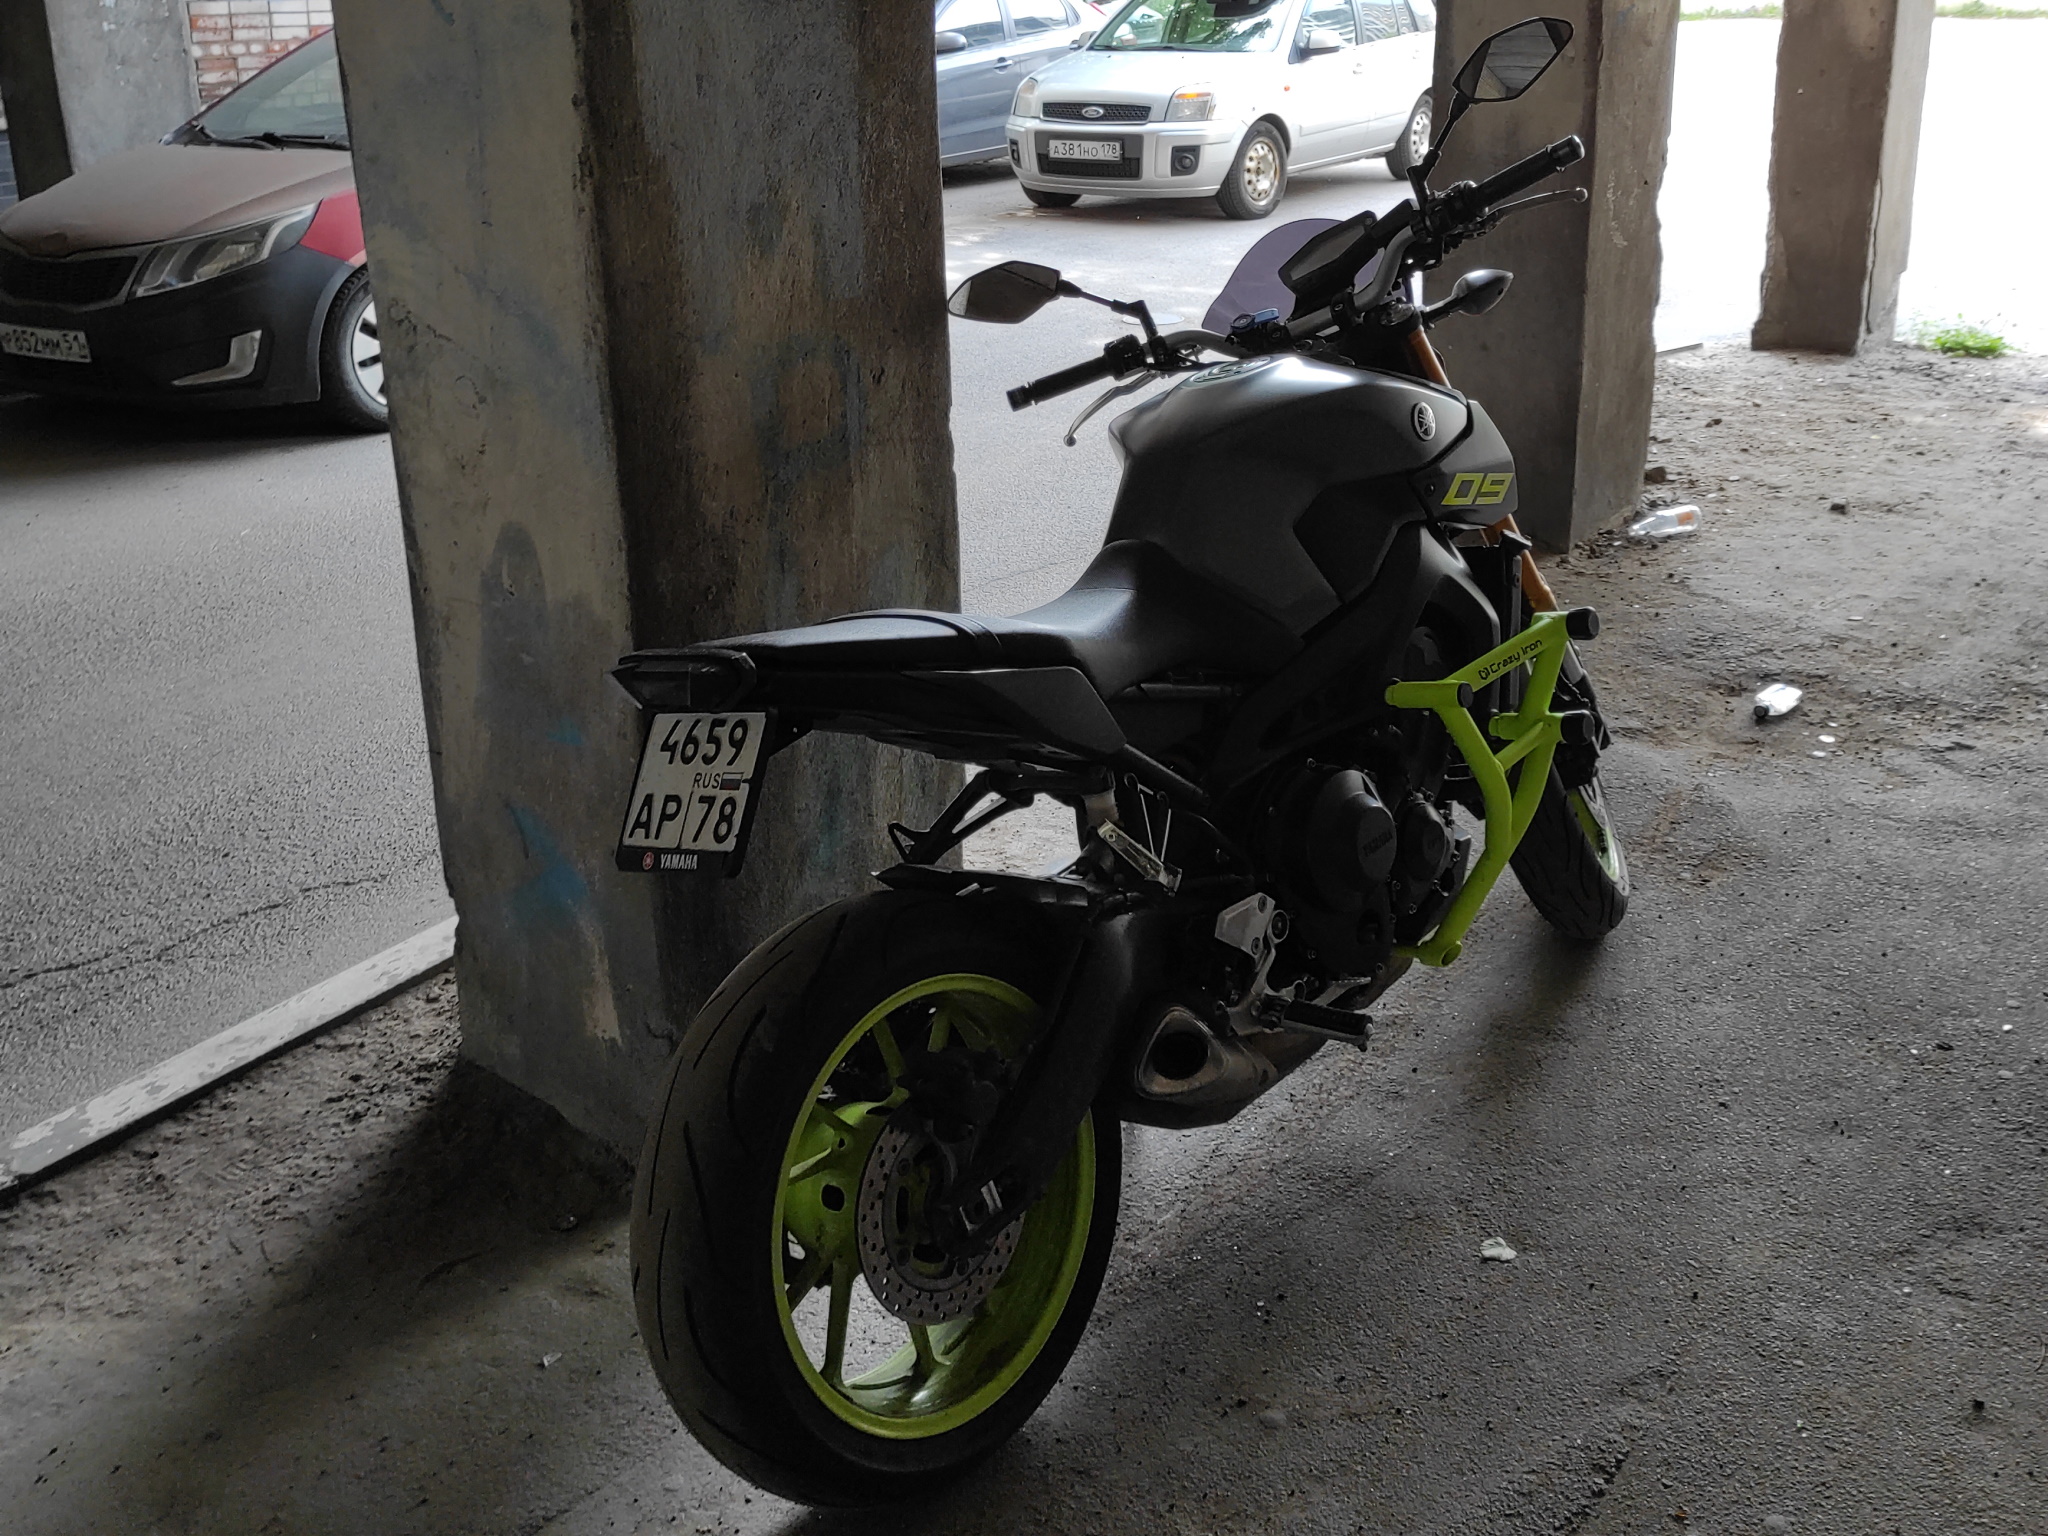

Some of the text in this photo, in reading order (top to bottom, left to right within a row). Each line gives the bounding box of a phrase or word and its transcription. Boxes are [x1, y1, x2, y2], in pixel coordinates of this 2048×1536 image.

[1101, 143, 1117, 155] 178
[1441, 472, 1514, 505] 09
[1489, 639, 1543, 674] Crazy Iron
[660, 718, 749, 767] 4659
[692, 772, 721, 789] RUS
[692, 795, 738, 845] 78
[660, 853, 699, 871] YAMAHA
